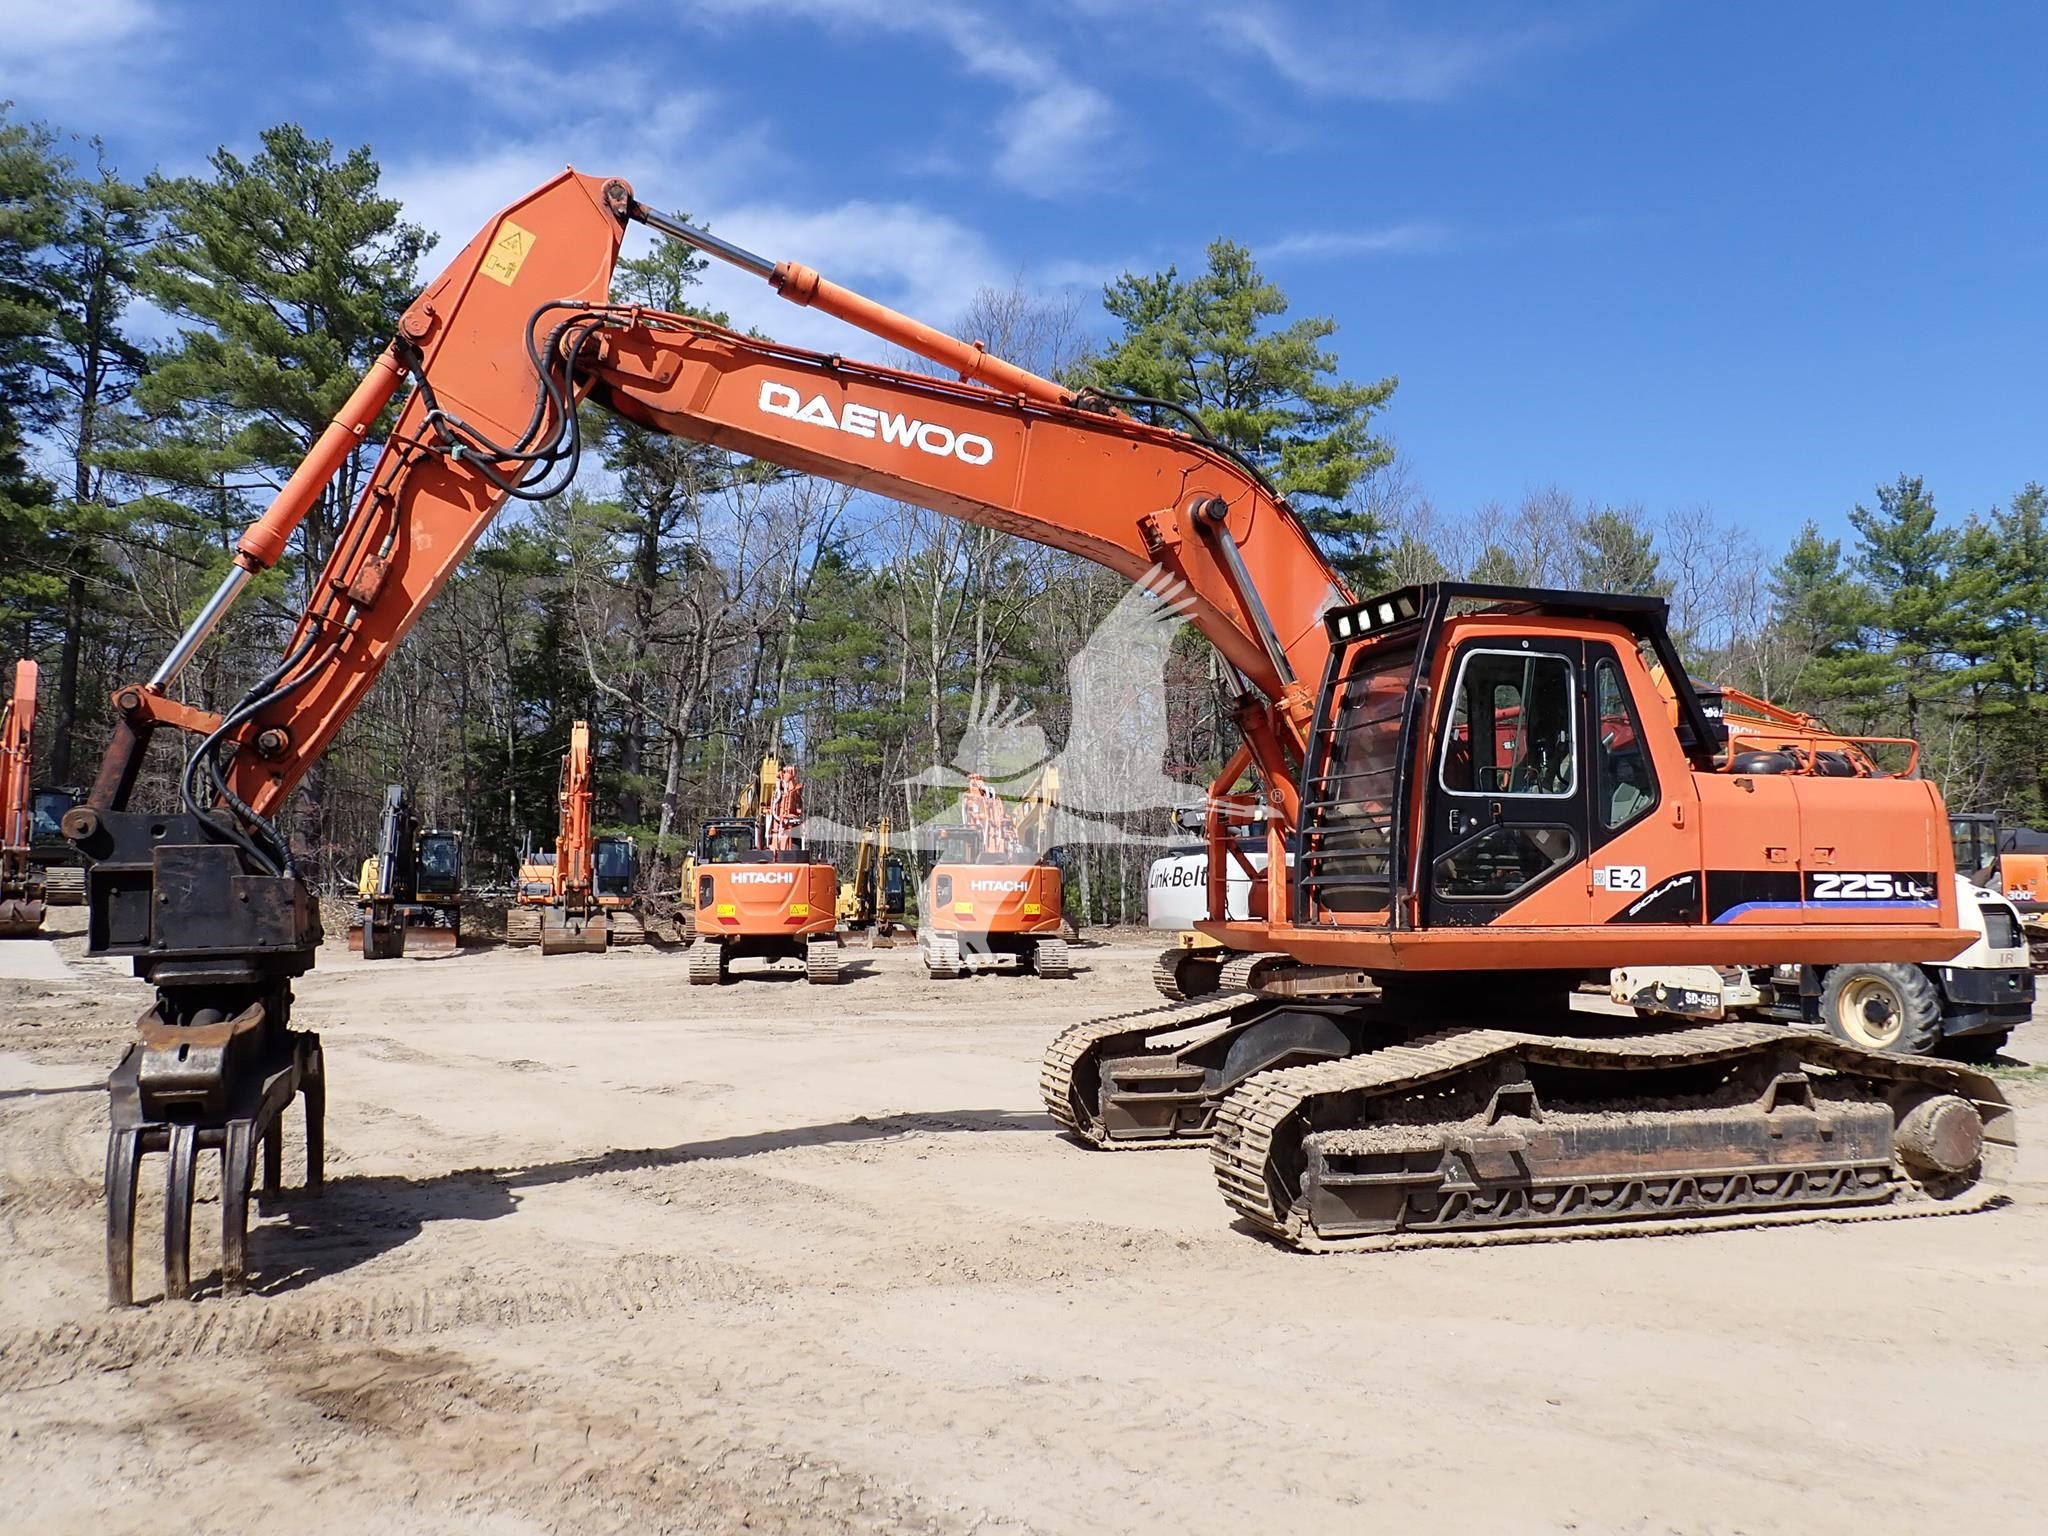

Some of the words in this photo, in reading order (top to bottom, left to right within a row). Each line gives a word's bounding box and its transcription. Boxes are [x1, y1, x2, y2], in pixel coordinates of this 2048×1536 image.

[758, 379, 994, 466] DAEWOO
[730, 871, 793, 884] HITACHI
[1609, 869, 1641, 888] E-2
[970, 880, 1028, 892] HITACHI
